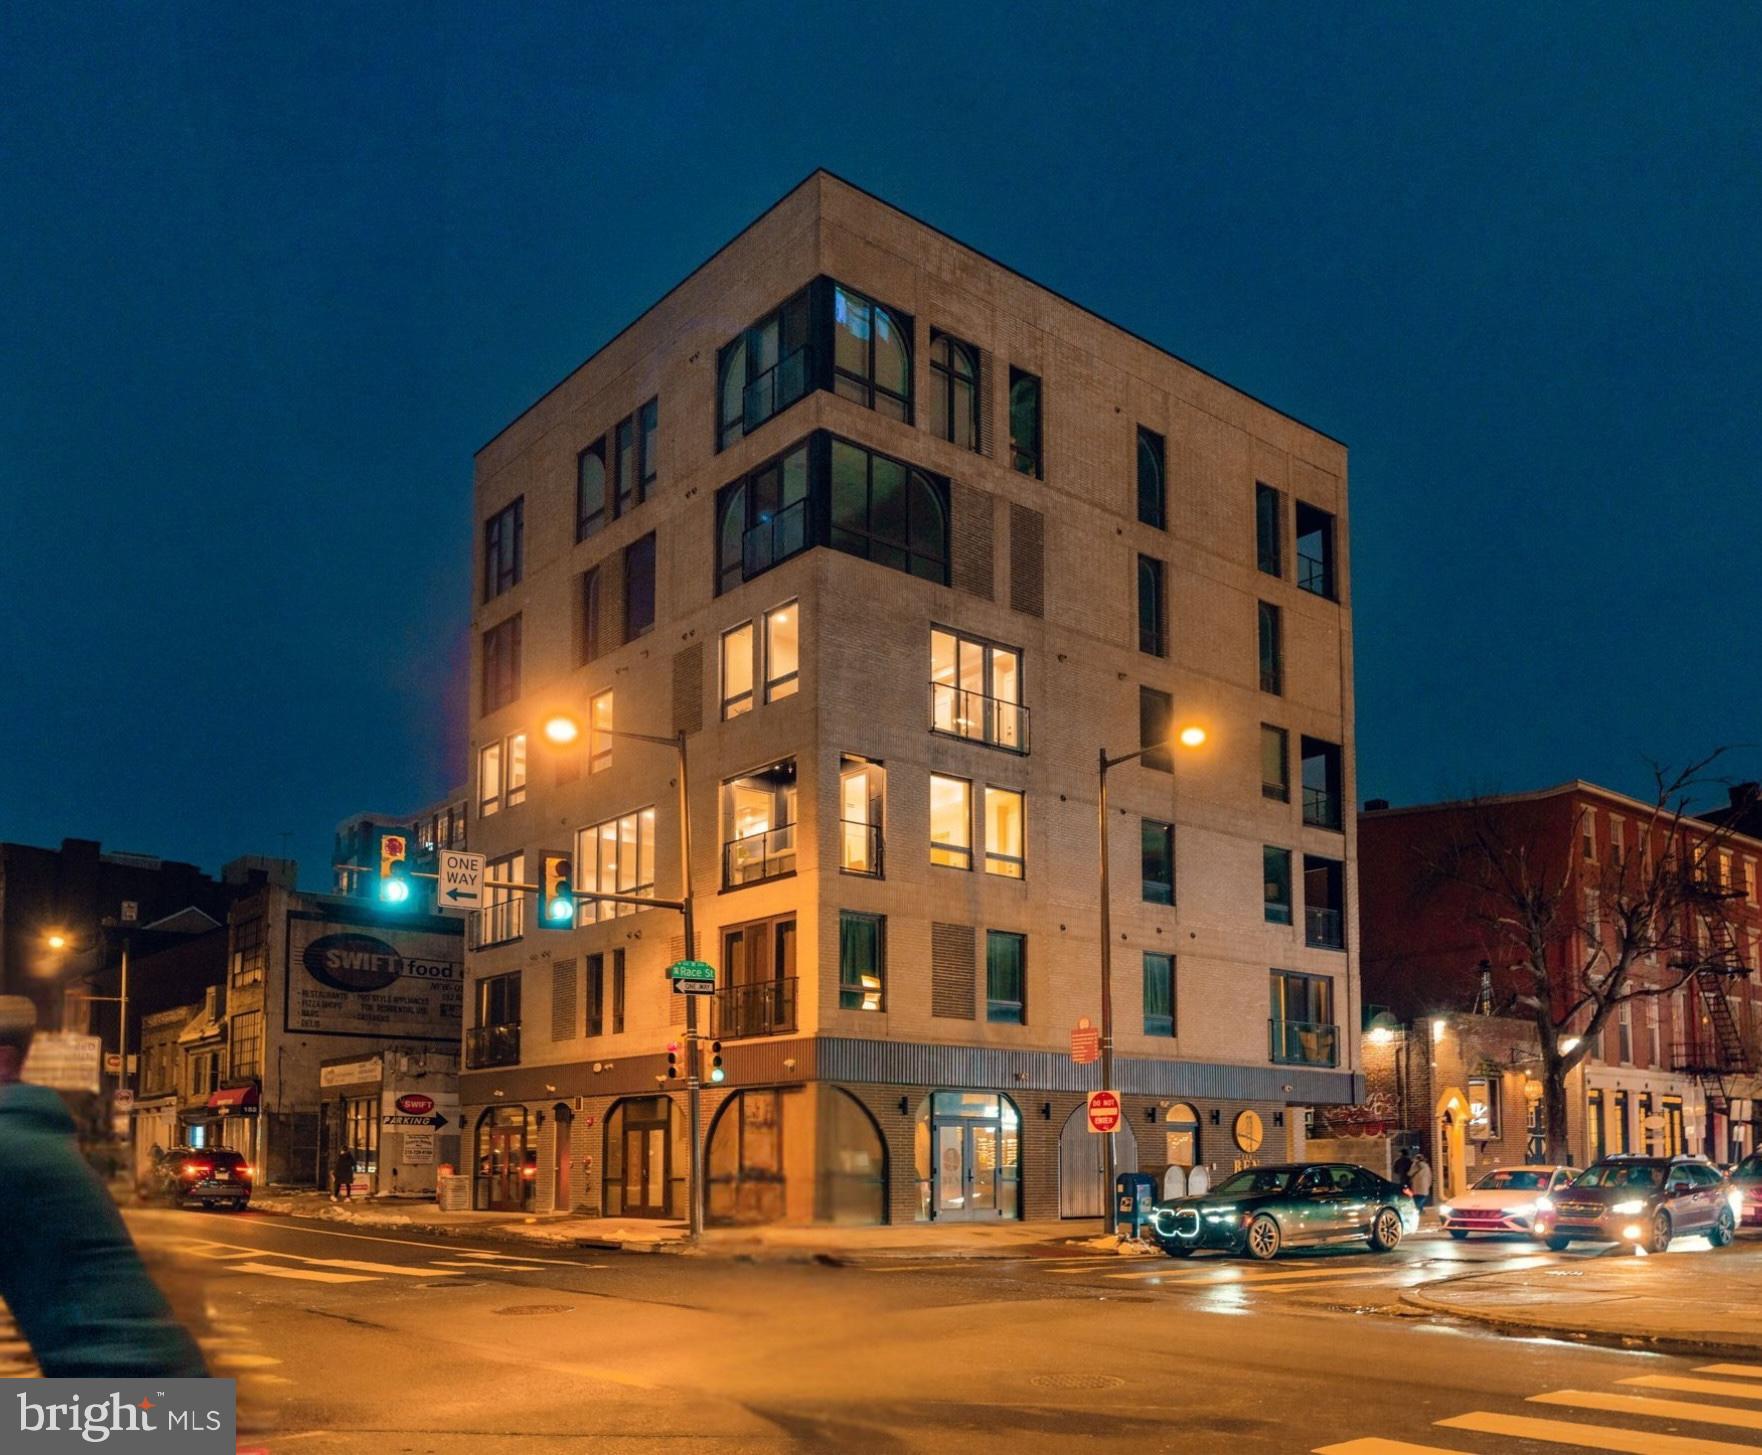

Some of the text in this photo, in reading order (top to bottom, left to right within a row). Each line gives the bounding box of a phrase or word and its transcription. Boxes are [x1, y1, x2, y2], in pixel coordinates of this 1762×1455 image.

[447, 856, 479, 871] ONE
[447, 871, 478, 885] WAY
[325, 949, 397, 973] SWIFT
[408, 960, 453, 978] food
[680, 966, 715, 978] Race St
[404, 1099, 433, 1109] SWIFT
[383, 1116, 430, 1125] PARKING
